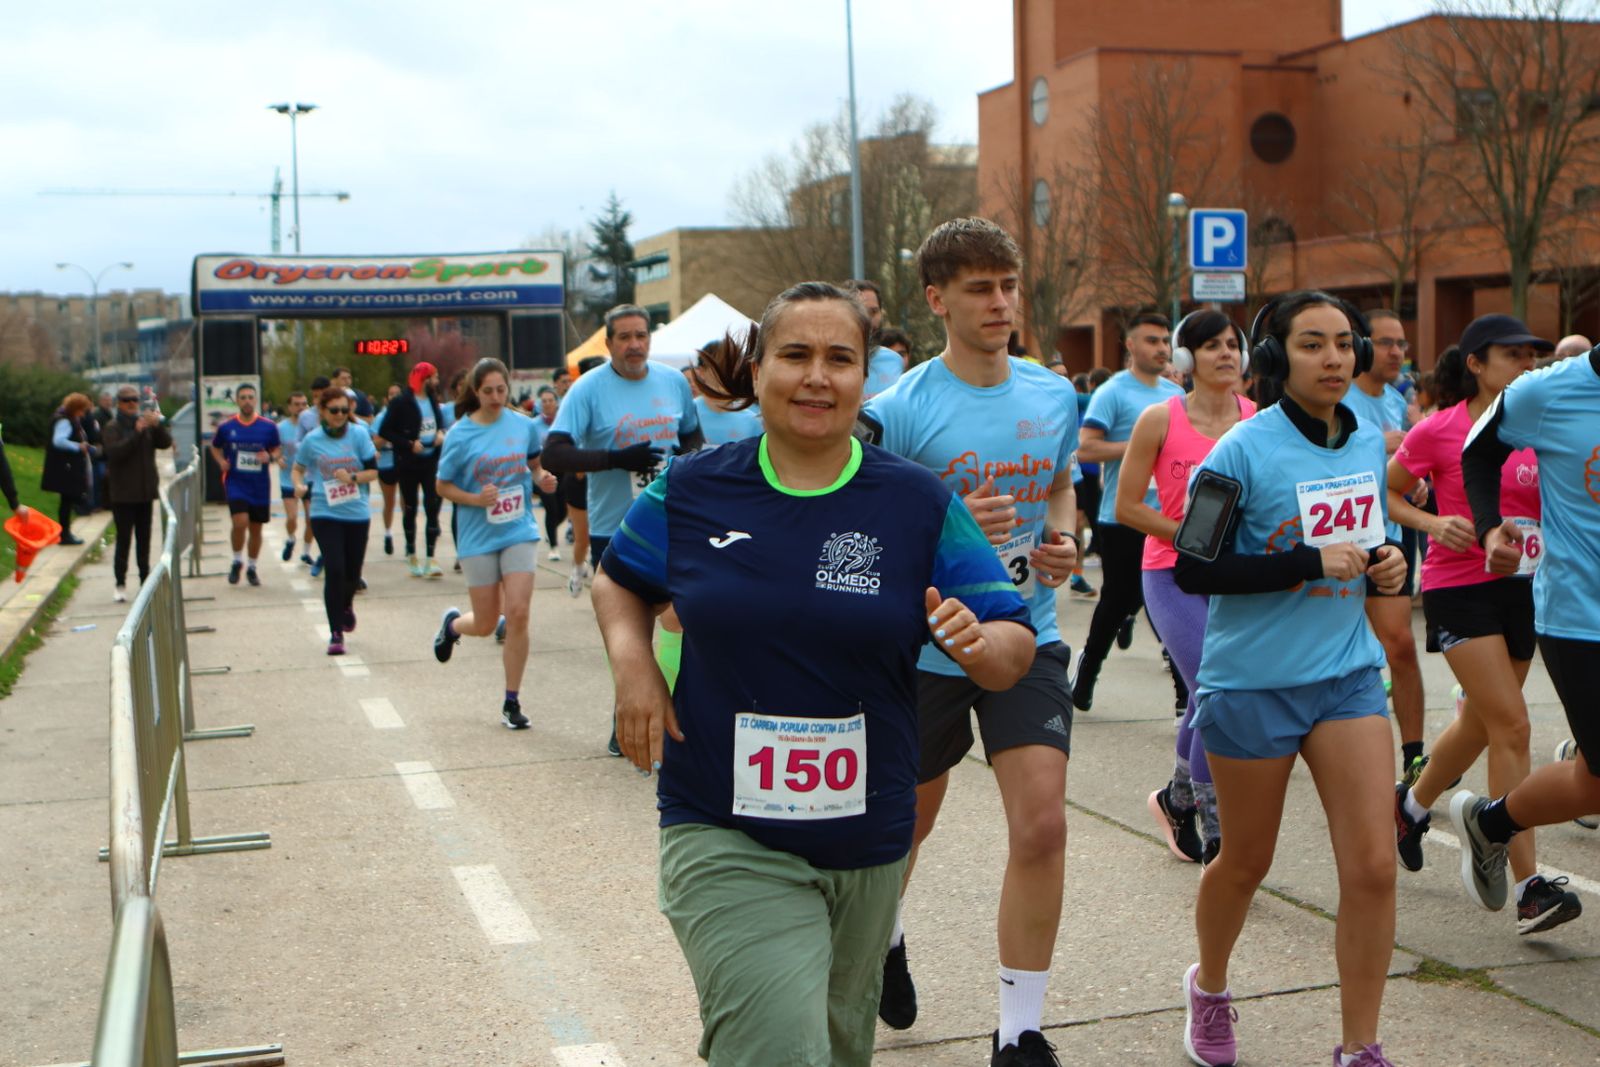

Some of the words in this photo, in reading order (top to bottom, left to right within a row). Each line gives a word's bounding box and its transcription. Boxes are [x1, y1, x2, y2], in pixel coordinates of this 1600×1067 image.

[1203, 216, 1236, 262] P
[214, 257, 549, 284] OrycronSport
[250, 288, 518, 307] www.orycronsport.com
[491, 495, 522, 516] 267
[1309, 494, 1375, 538] 247
[815, 570, 880, 588] OLMEDO
[826, 583, 868, 594] RUNNING
[740, 717, 748, 728] II
[750, 718, 778, 732] CARRERA
[780, 721, 809, 734] POPULAR
[810, 723, 837, 734] CONTRA
[838, 723, 845, 733] EL
[748, 746, 858, 793] 150
